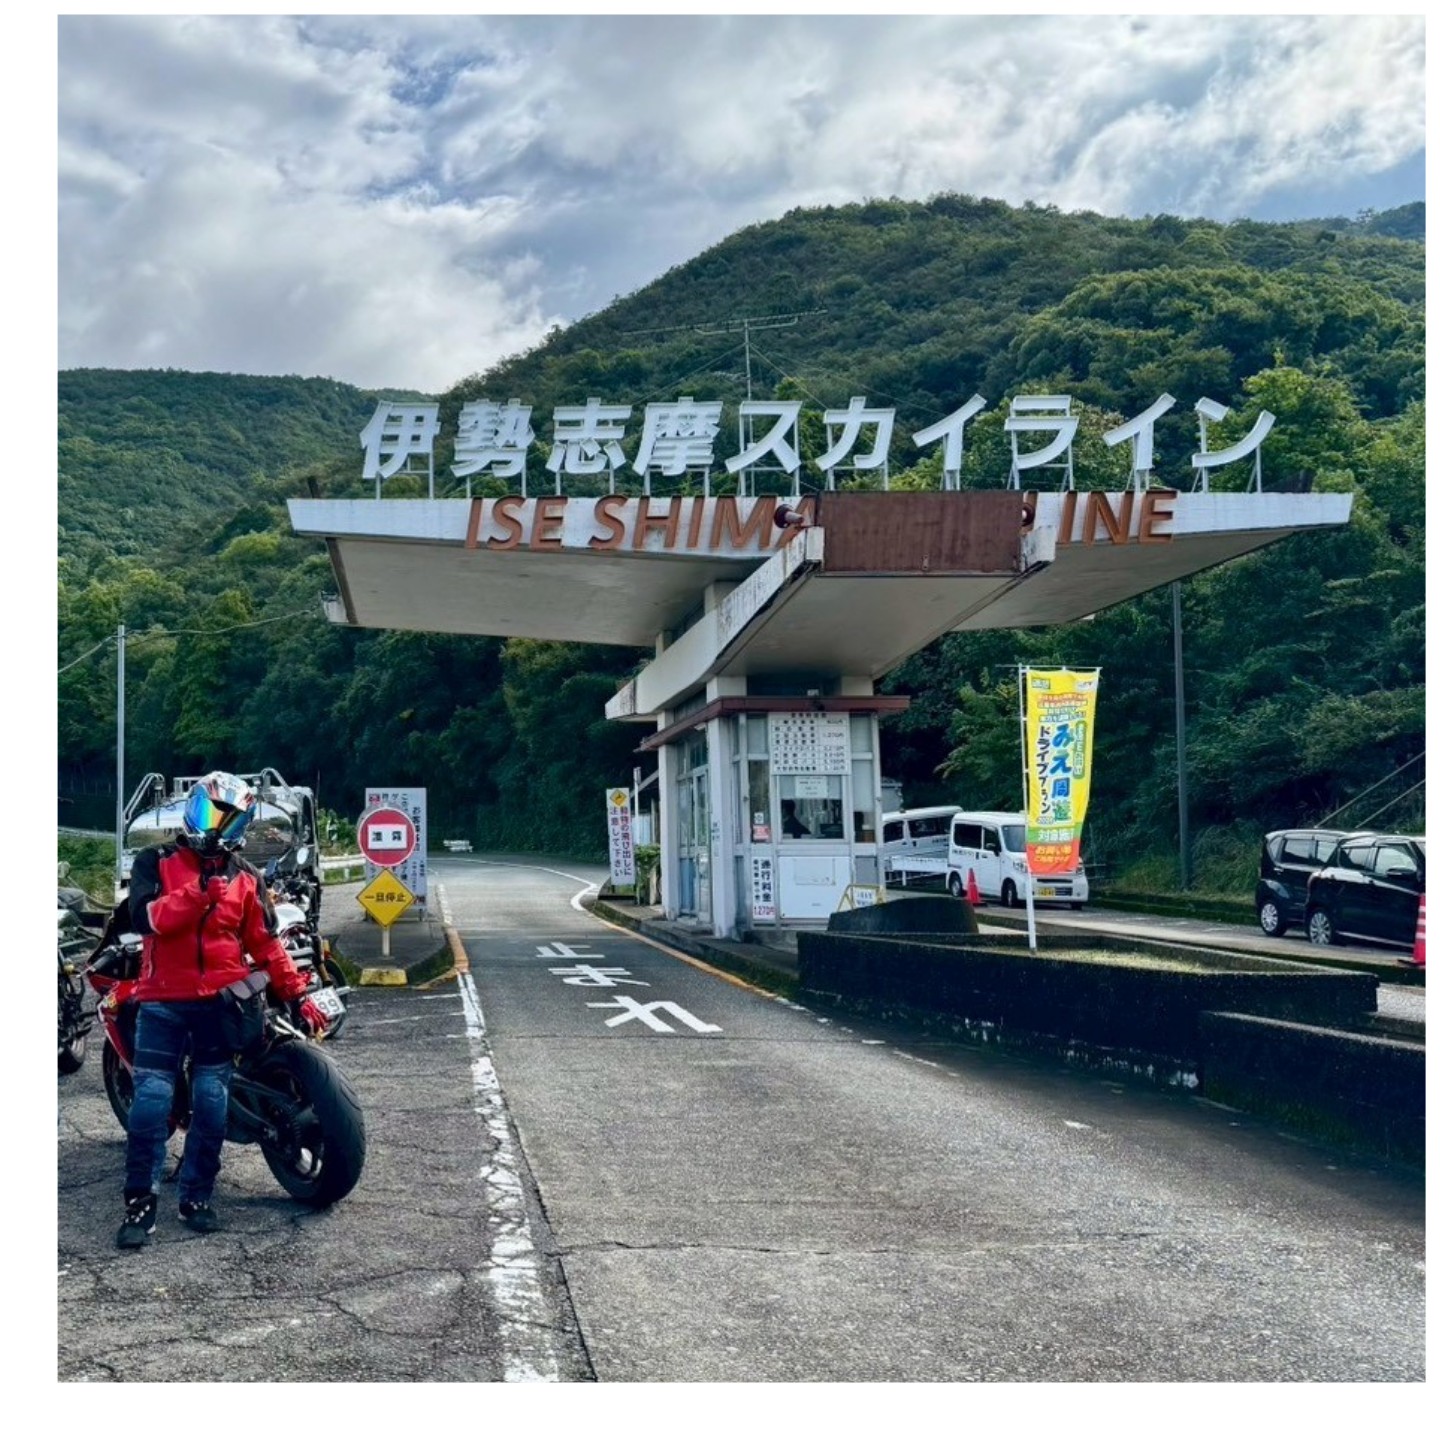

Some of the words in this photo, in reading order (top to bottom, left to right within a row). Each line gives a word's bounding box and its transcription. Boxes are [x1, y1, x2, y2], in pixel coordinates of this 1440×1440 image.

[360, 393, 1276, 479] 伊勢志摩スカイライン
[465, 495, 568, 549] ISE
[365, 892, 406, 903] 一旦停止
[536, 942, 723, 1033] 止まれ
